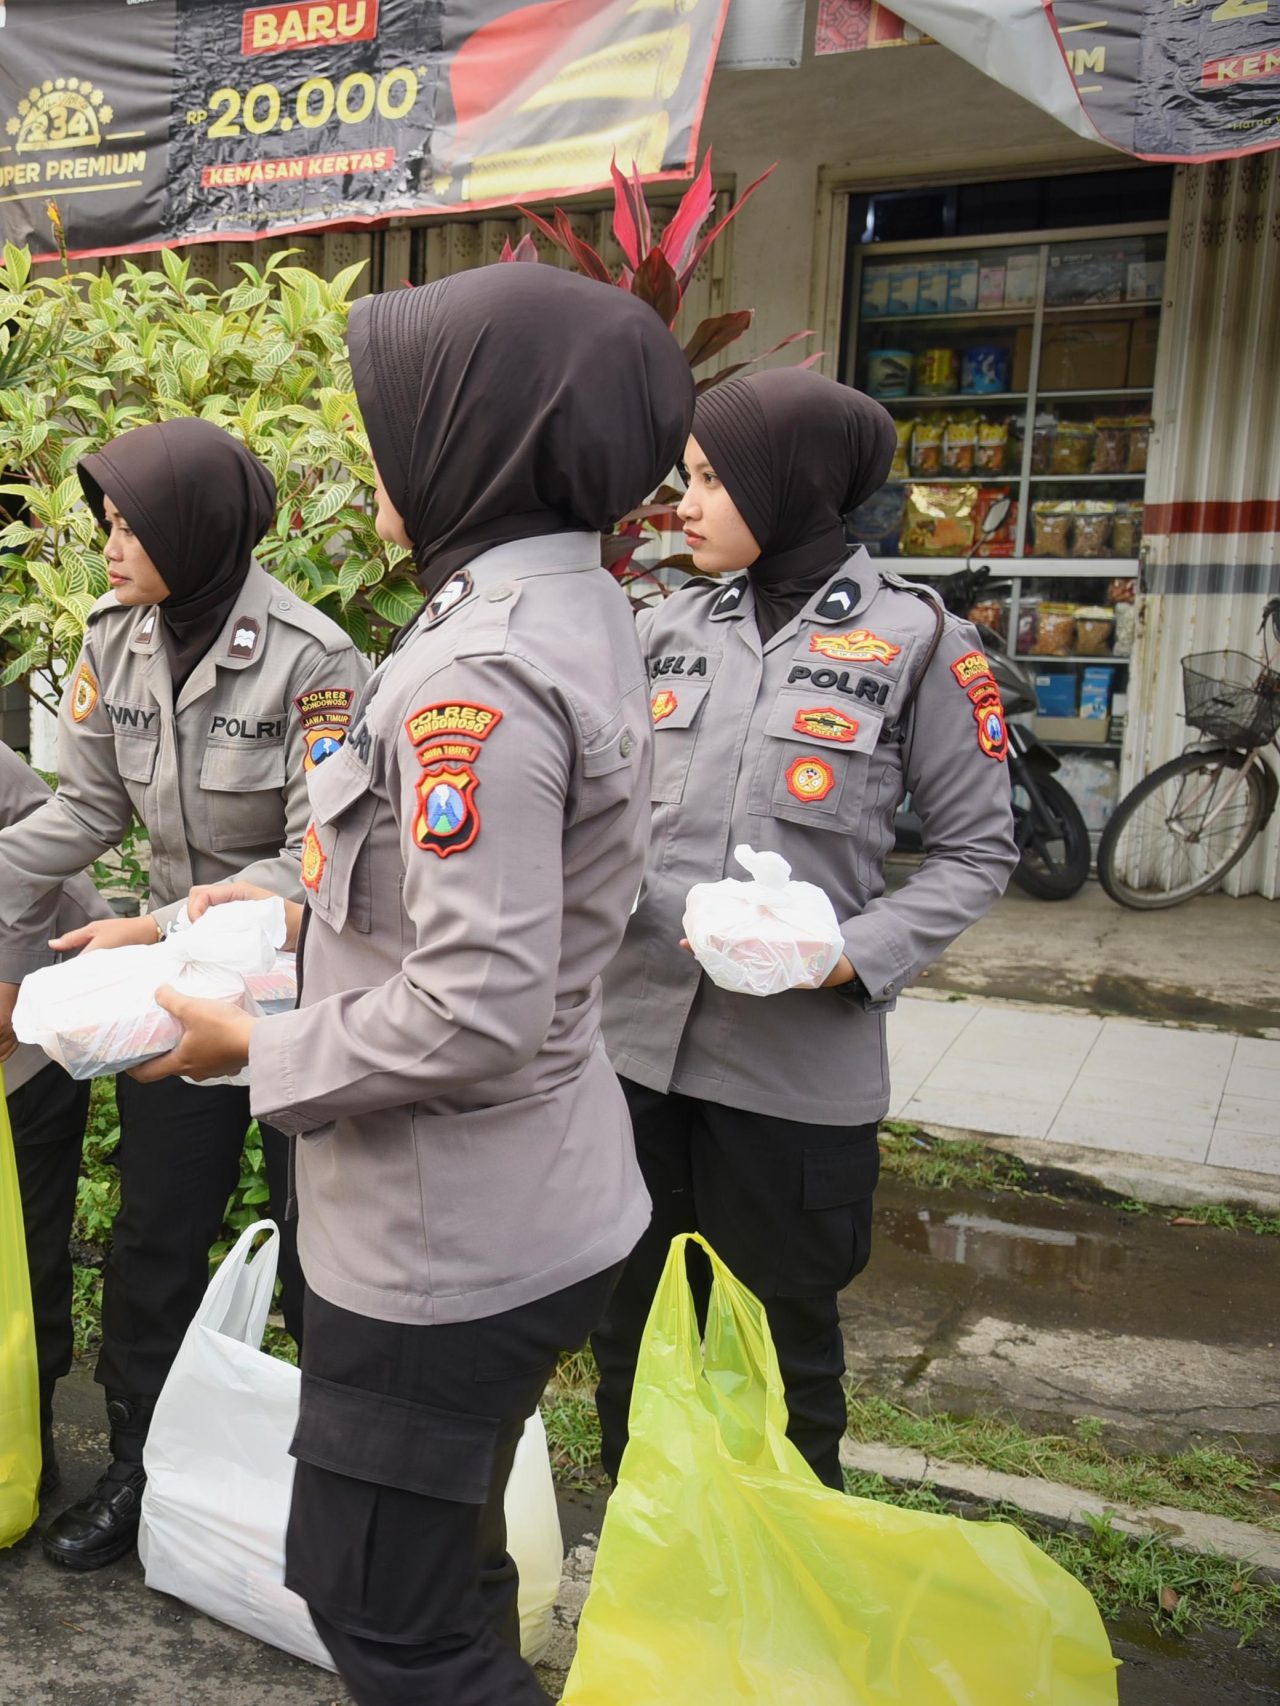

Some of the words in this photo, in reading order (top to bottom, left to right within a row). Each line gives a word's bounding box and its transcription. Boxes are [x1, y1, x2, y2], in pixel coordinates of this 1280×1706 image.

[252, 1, 367, 48] BARU
[27, 106, 89, 143] 234
[186, 109, 208, 125] RP
[46, 150, 147, 181] PREMIUM
[209, 160, 304, 185] KEMASAN
[308, 151, 387, 176] KERTAS
[787, 665, 890, 706] POLRI
[302, 691, 346, 706] POLRES
[302, 698, 348, 712] BONDOWOSO
[210, 715, 282, 739] POLRI
[304, 715, 325, 727] JAWA
[326, 714, 349, 724] TIMUR
[408, 706, 494, 728] POLRES
